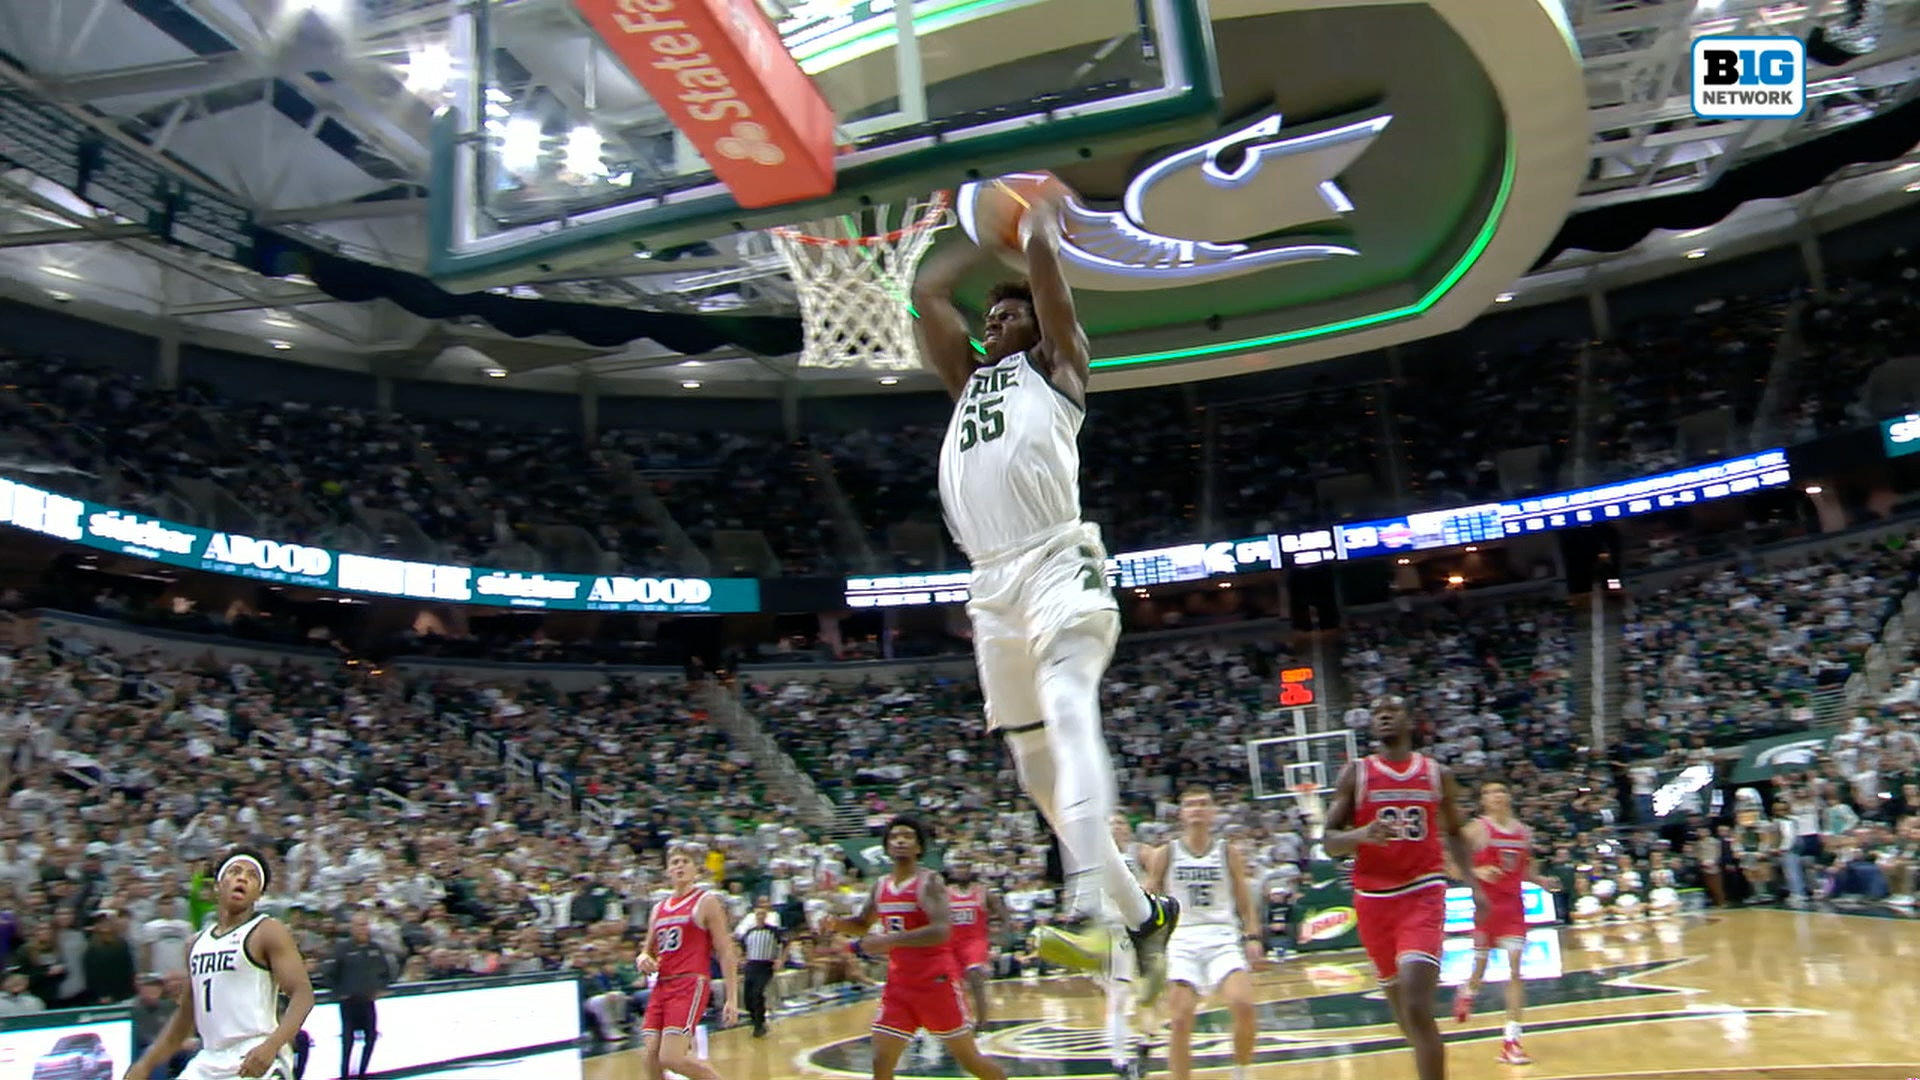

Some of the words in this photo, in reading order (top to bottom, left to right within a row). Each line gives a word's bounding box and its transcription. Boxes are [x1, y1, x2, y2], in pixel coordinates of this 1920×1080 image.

[960, 395, 1004, 453] 55
[191, 948, 238, 977] STATE
[202, 977, 213, 1013] 1
